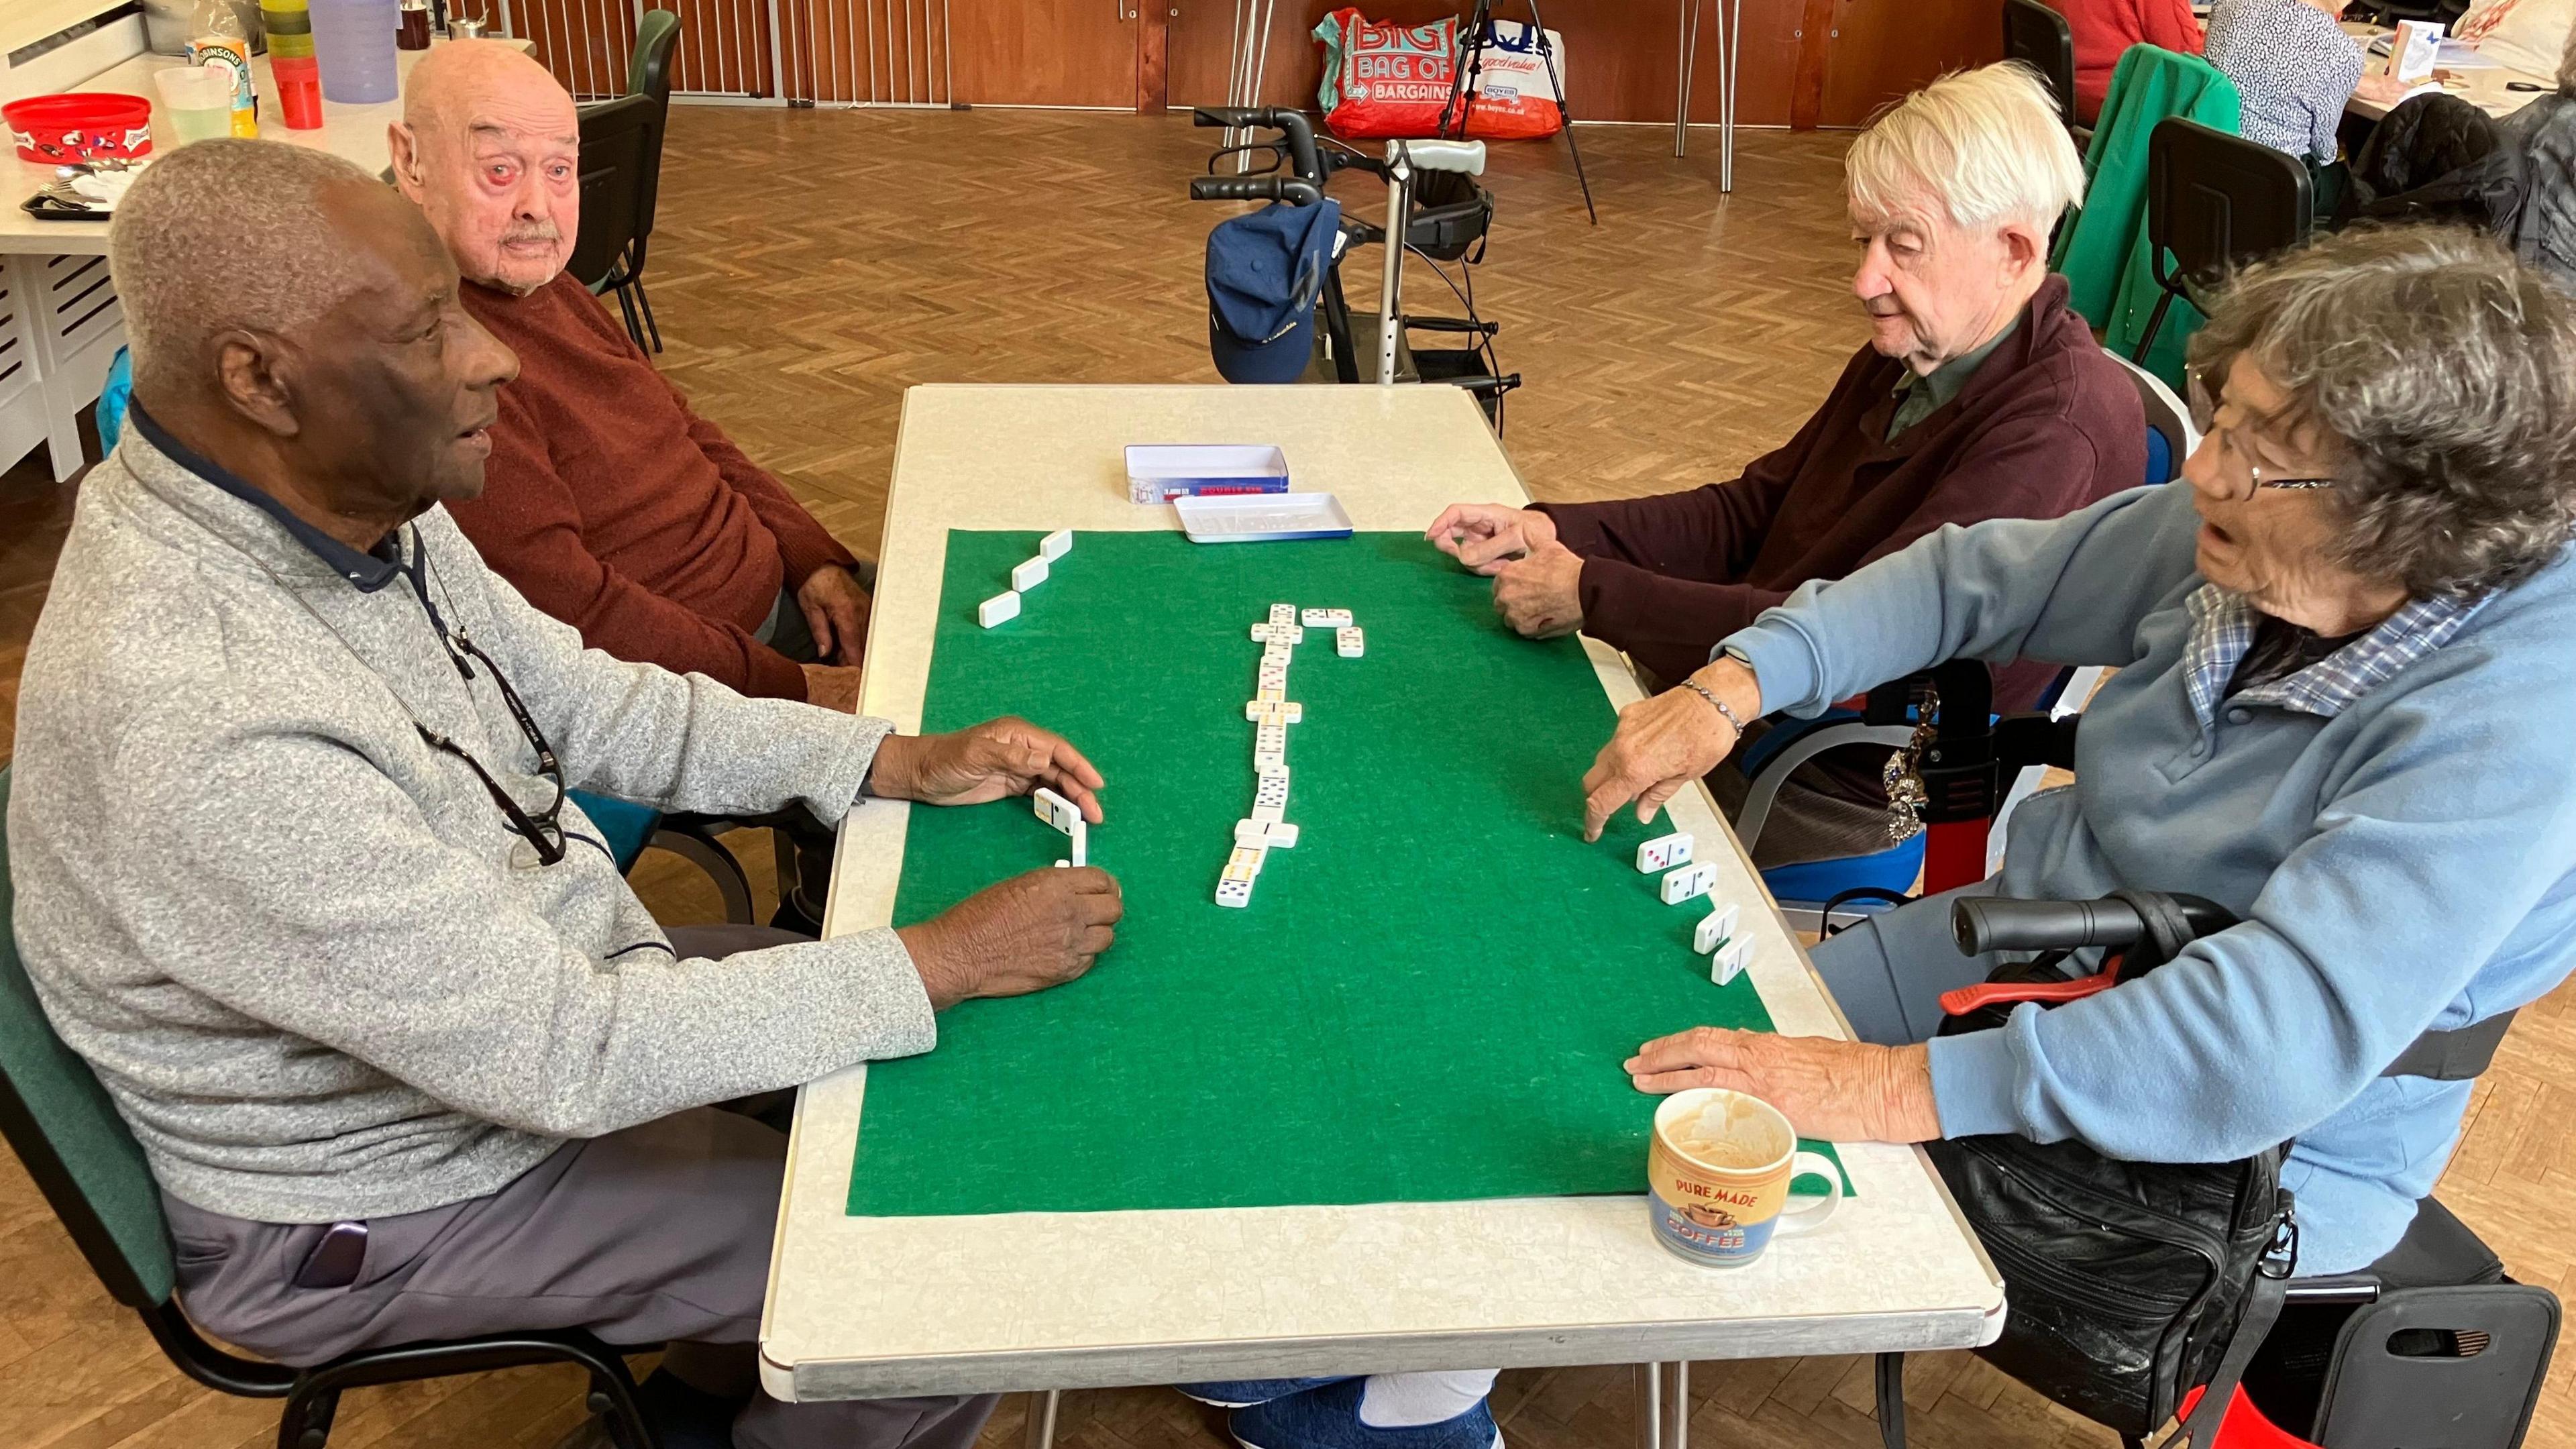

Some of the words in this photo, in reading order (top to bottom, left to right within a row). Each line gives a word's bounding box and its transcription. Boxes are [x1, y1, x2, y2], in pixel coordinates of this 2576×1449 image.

[1353, 21, 1442, 52] BIG
[1358, 56, 1410, 78] BAG
[1419, 58, 1450, 80] OF
[1375, 84, 1454, 100] BARGAINS
[1676, 1179, 1711, 1198] PURE
[1713, 1188, 1758, 1208] MADE
[1667, 1218, 1745, 1248] COFFEE
